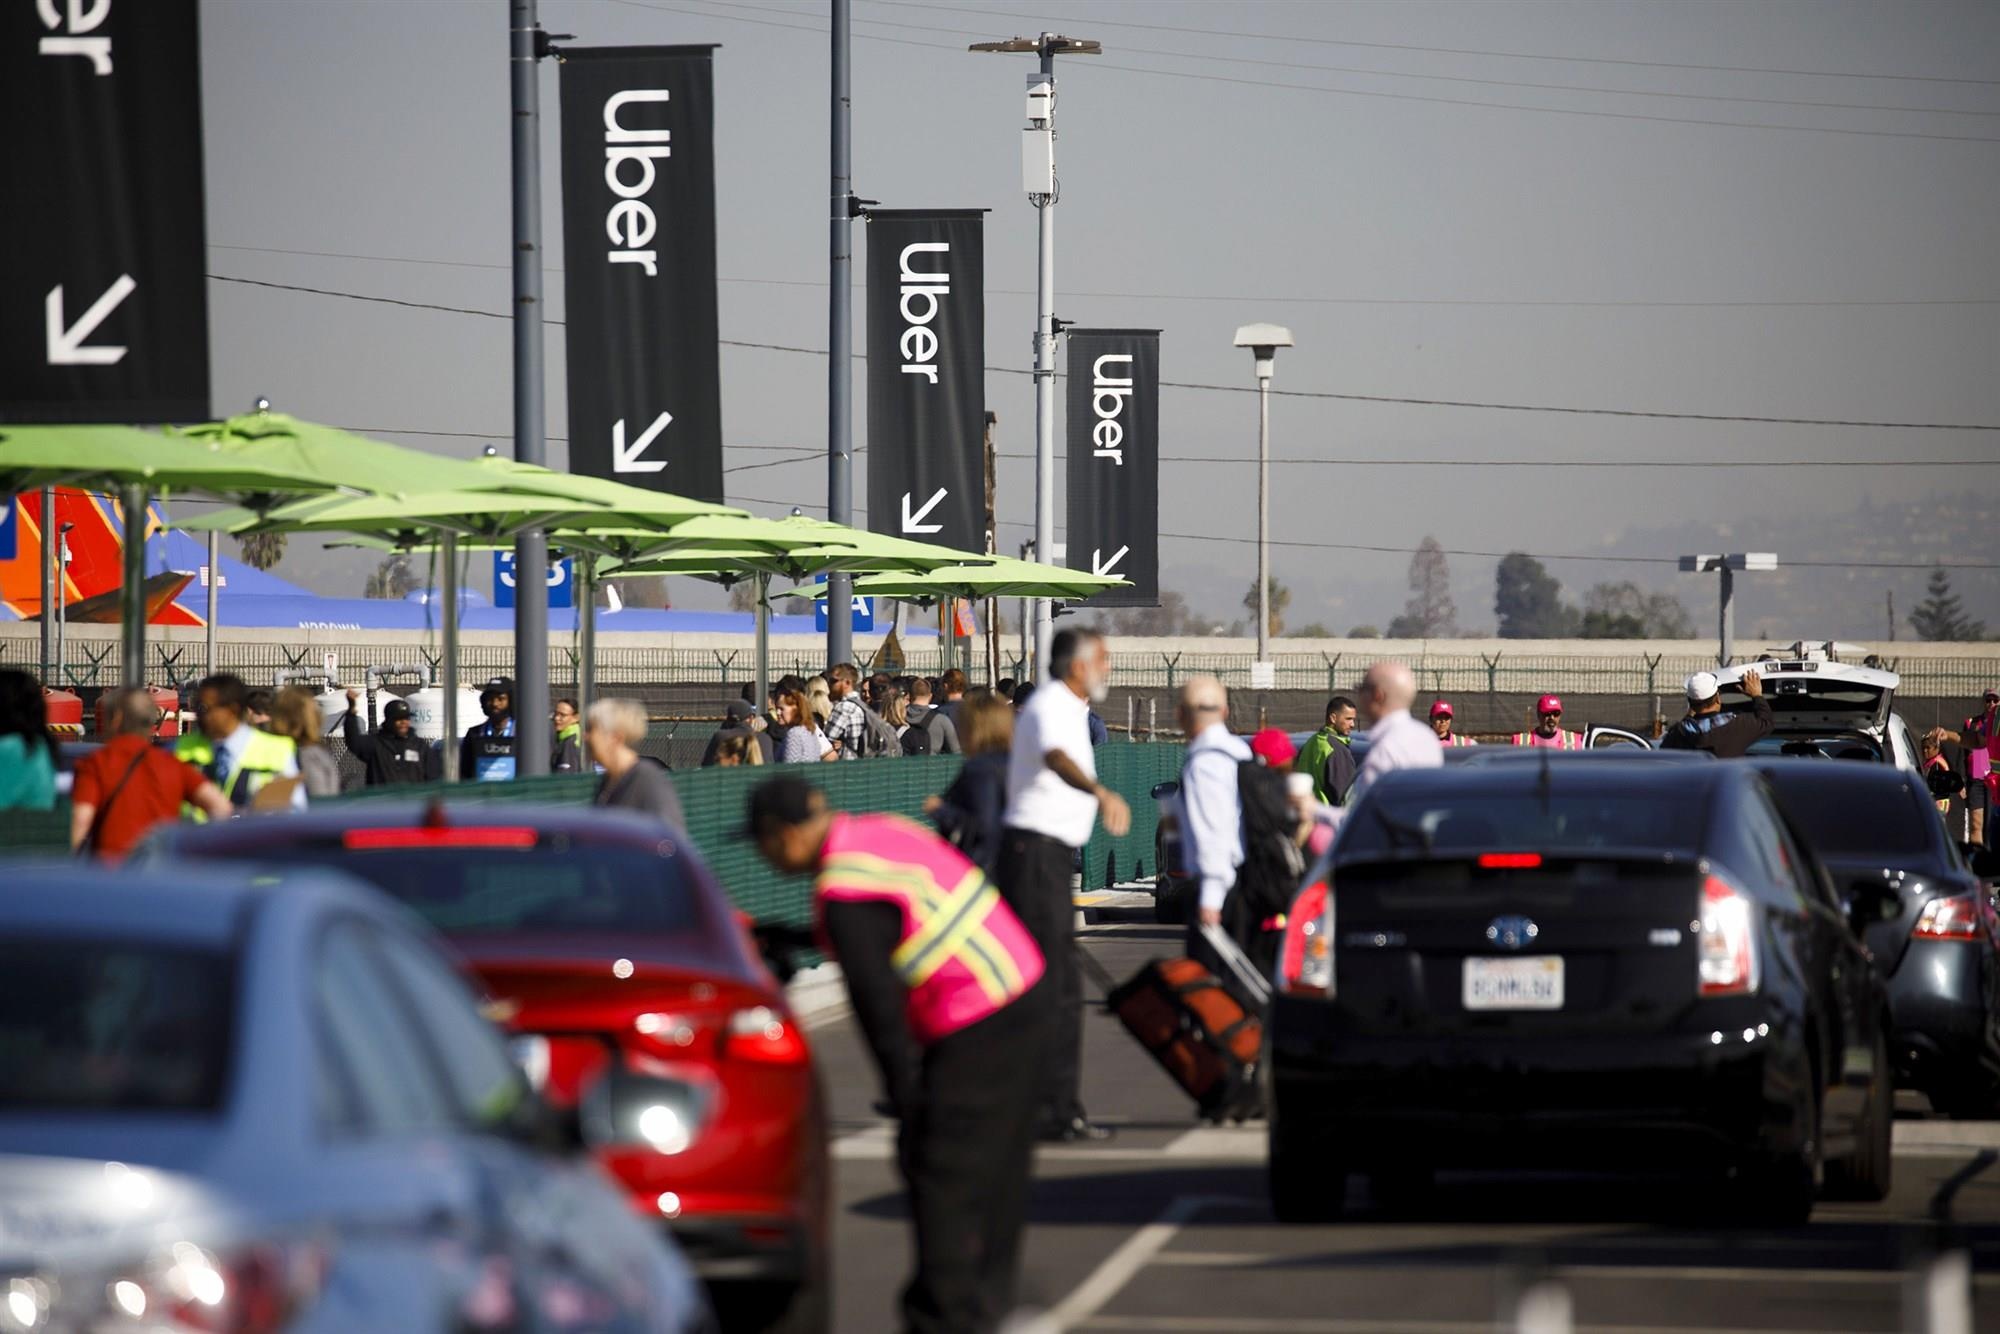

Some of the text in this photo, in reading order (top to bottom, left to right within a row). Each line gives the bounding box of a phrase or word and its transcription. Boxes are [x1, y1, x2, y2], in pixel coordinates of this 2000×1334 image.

[604, 90, 670, 276] Uber
[900, 243, 949, 383] Uber
[1093, 354, 1133, 465] Uber
[484, 743, 512, 754] Uber
